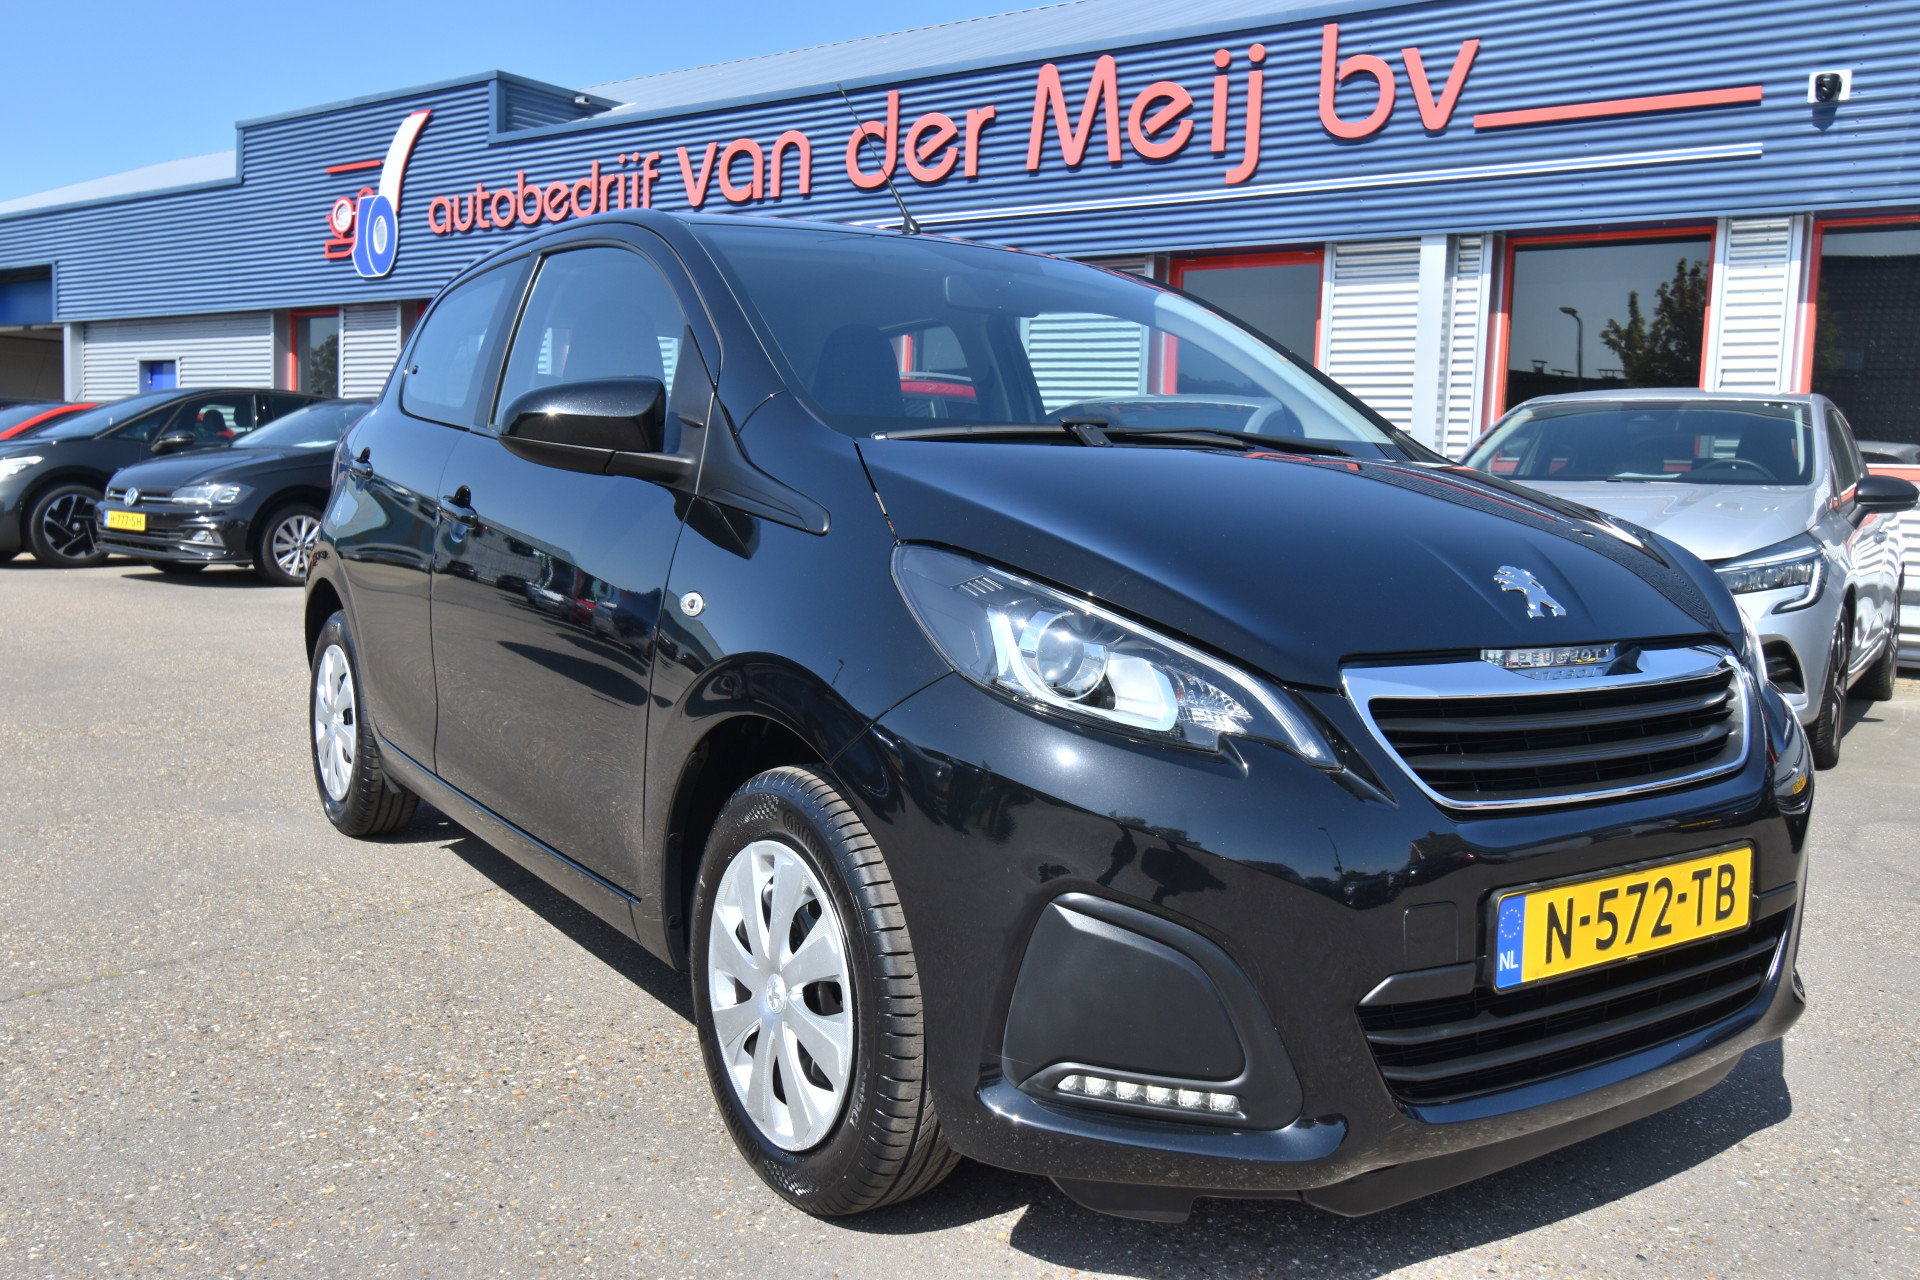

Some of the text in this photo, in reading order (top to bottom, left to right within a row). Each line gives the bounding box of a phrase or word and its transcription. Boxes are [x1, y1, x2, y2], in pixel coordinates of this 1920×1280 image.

[428, 23, 1480, 234] autobedrijf van der Meij bv
[1517, 648, 1602, 665] PEUGEOT
[1545, 863, 1736, 964] N-572-TB
[1499, 950, 1519, 971] NL
